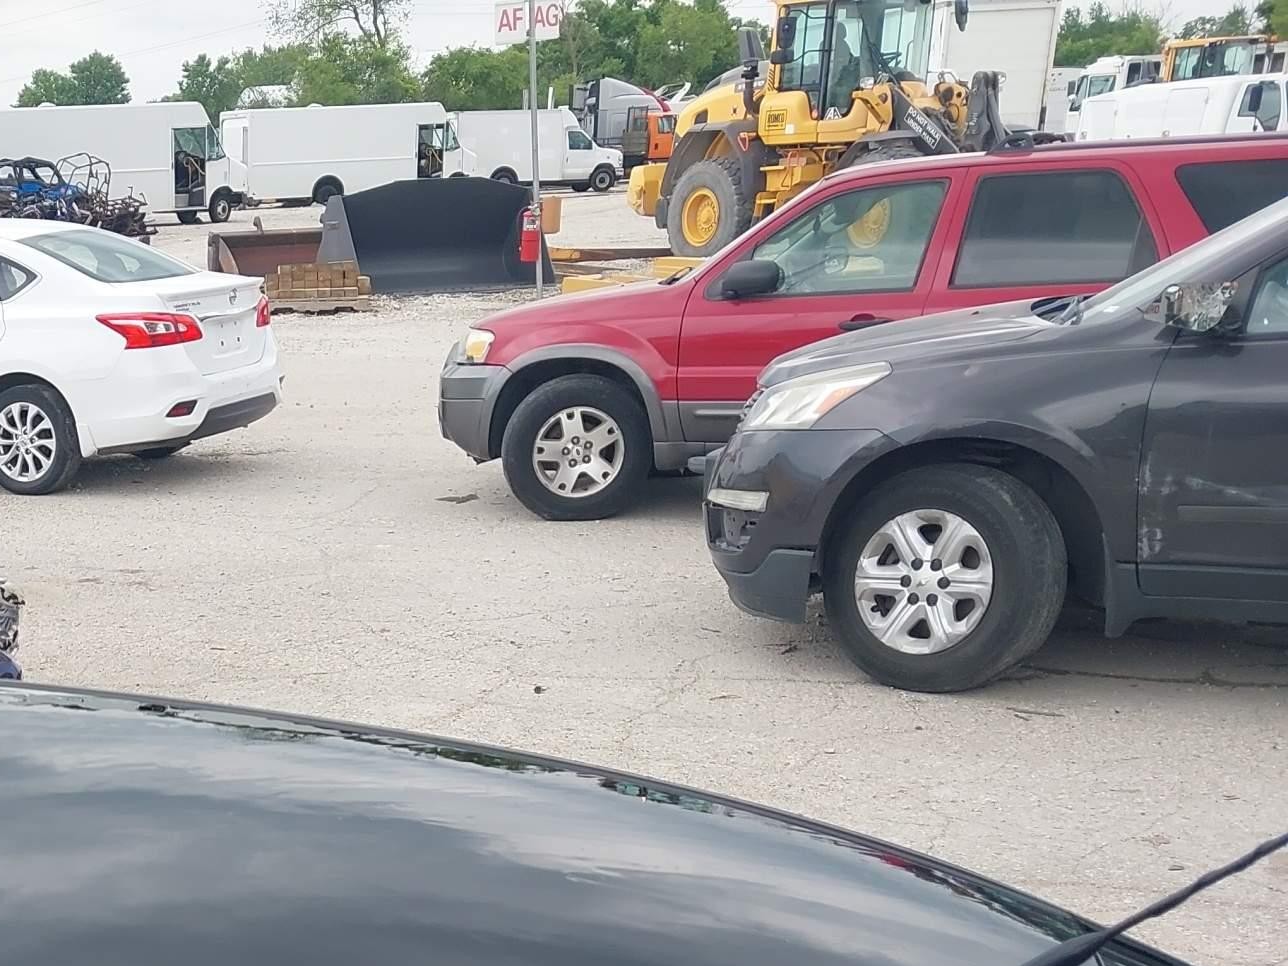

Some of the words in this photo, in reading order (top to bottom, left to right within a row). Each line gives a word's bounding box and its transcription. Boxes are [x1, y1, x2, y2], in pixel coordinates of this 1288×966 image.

[498, 7, 523, 32] AF
[535, 4, 558, 27] AG
[907, 117, 923, 134] UNDER
[921, 131, 935, 145] MAST
[916, 114, 928, 127] NOT
[926, 123, 940, 139] WALK
